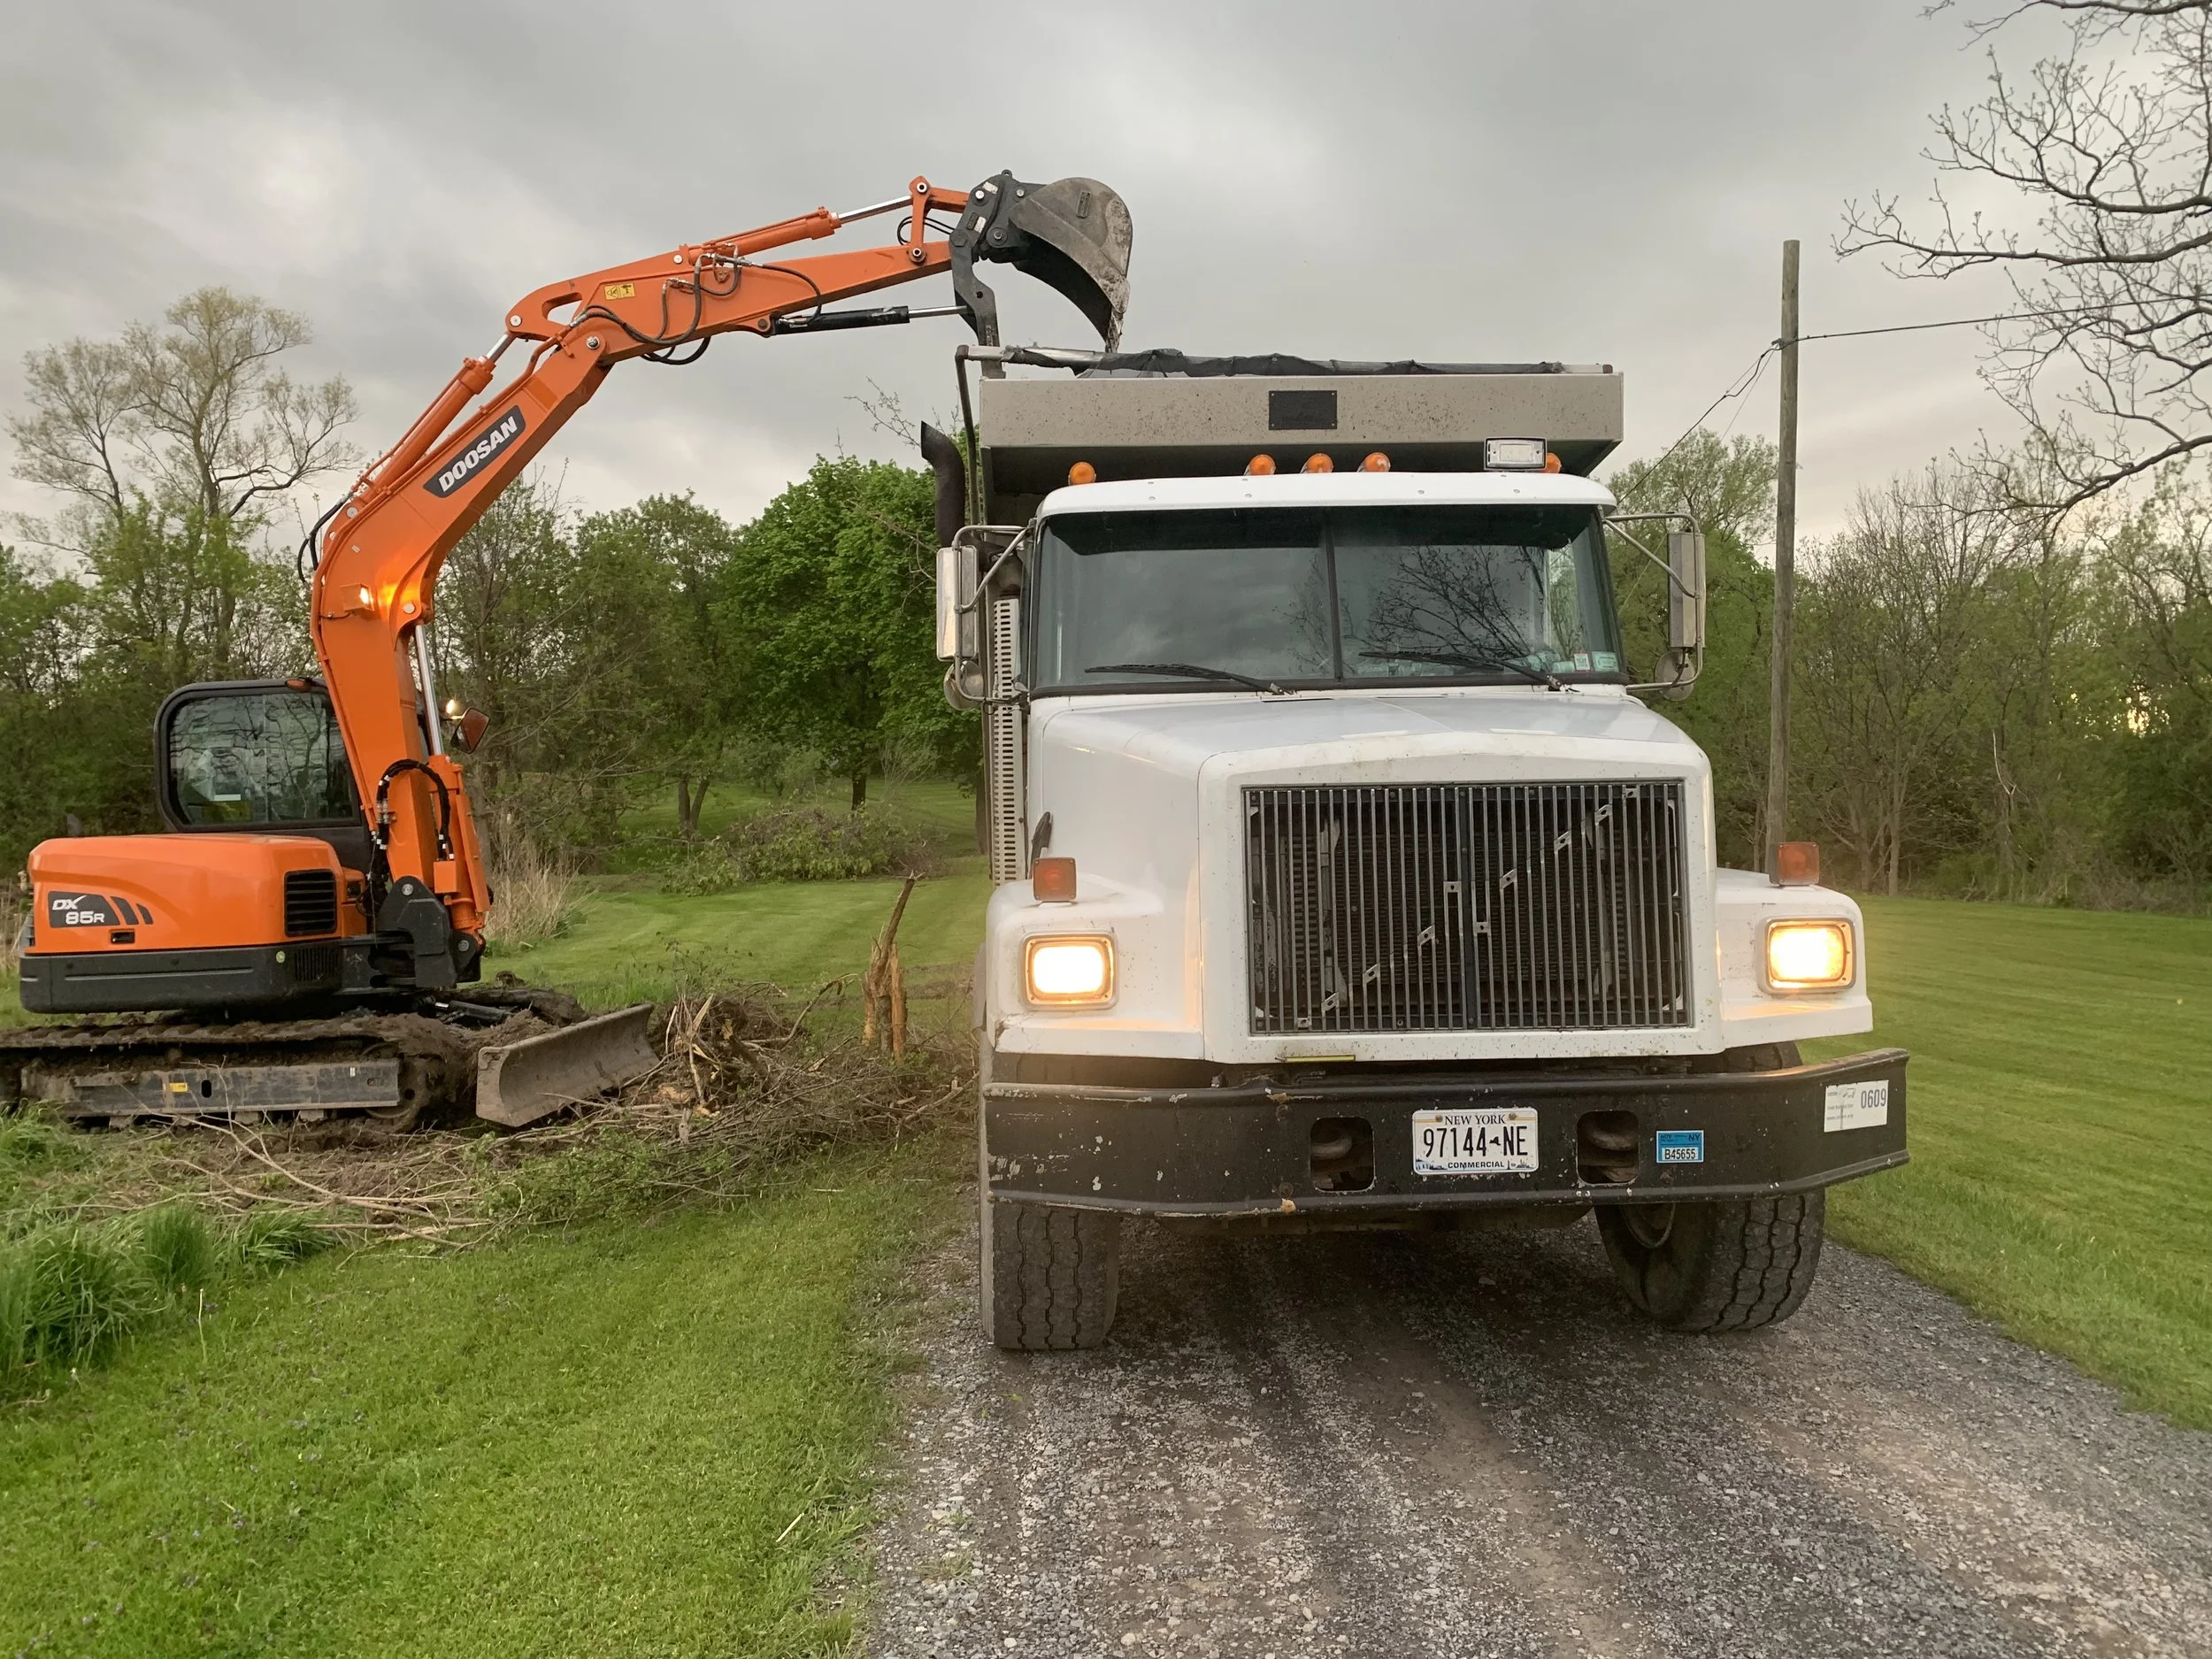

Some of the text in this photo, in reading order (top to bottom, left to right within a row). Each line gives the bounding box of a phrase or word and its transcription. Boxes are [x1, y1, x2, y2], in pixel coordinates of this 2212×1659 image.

[438, 416, 518, 492] DOOSAN
[52, 895, 87, 910] DX
[65, 910, 104, 925] 85R
[1861, 1088, 1886, 1109] 0609
[1445, 1114, 1506, 1125] NEW YORK
[1423, 1125, 1528, 1157] 97144 NE
[1664, 1148, 1696, 1159] B45655
